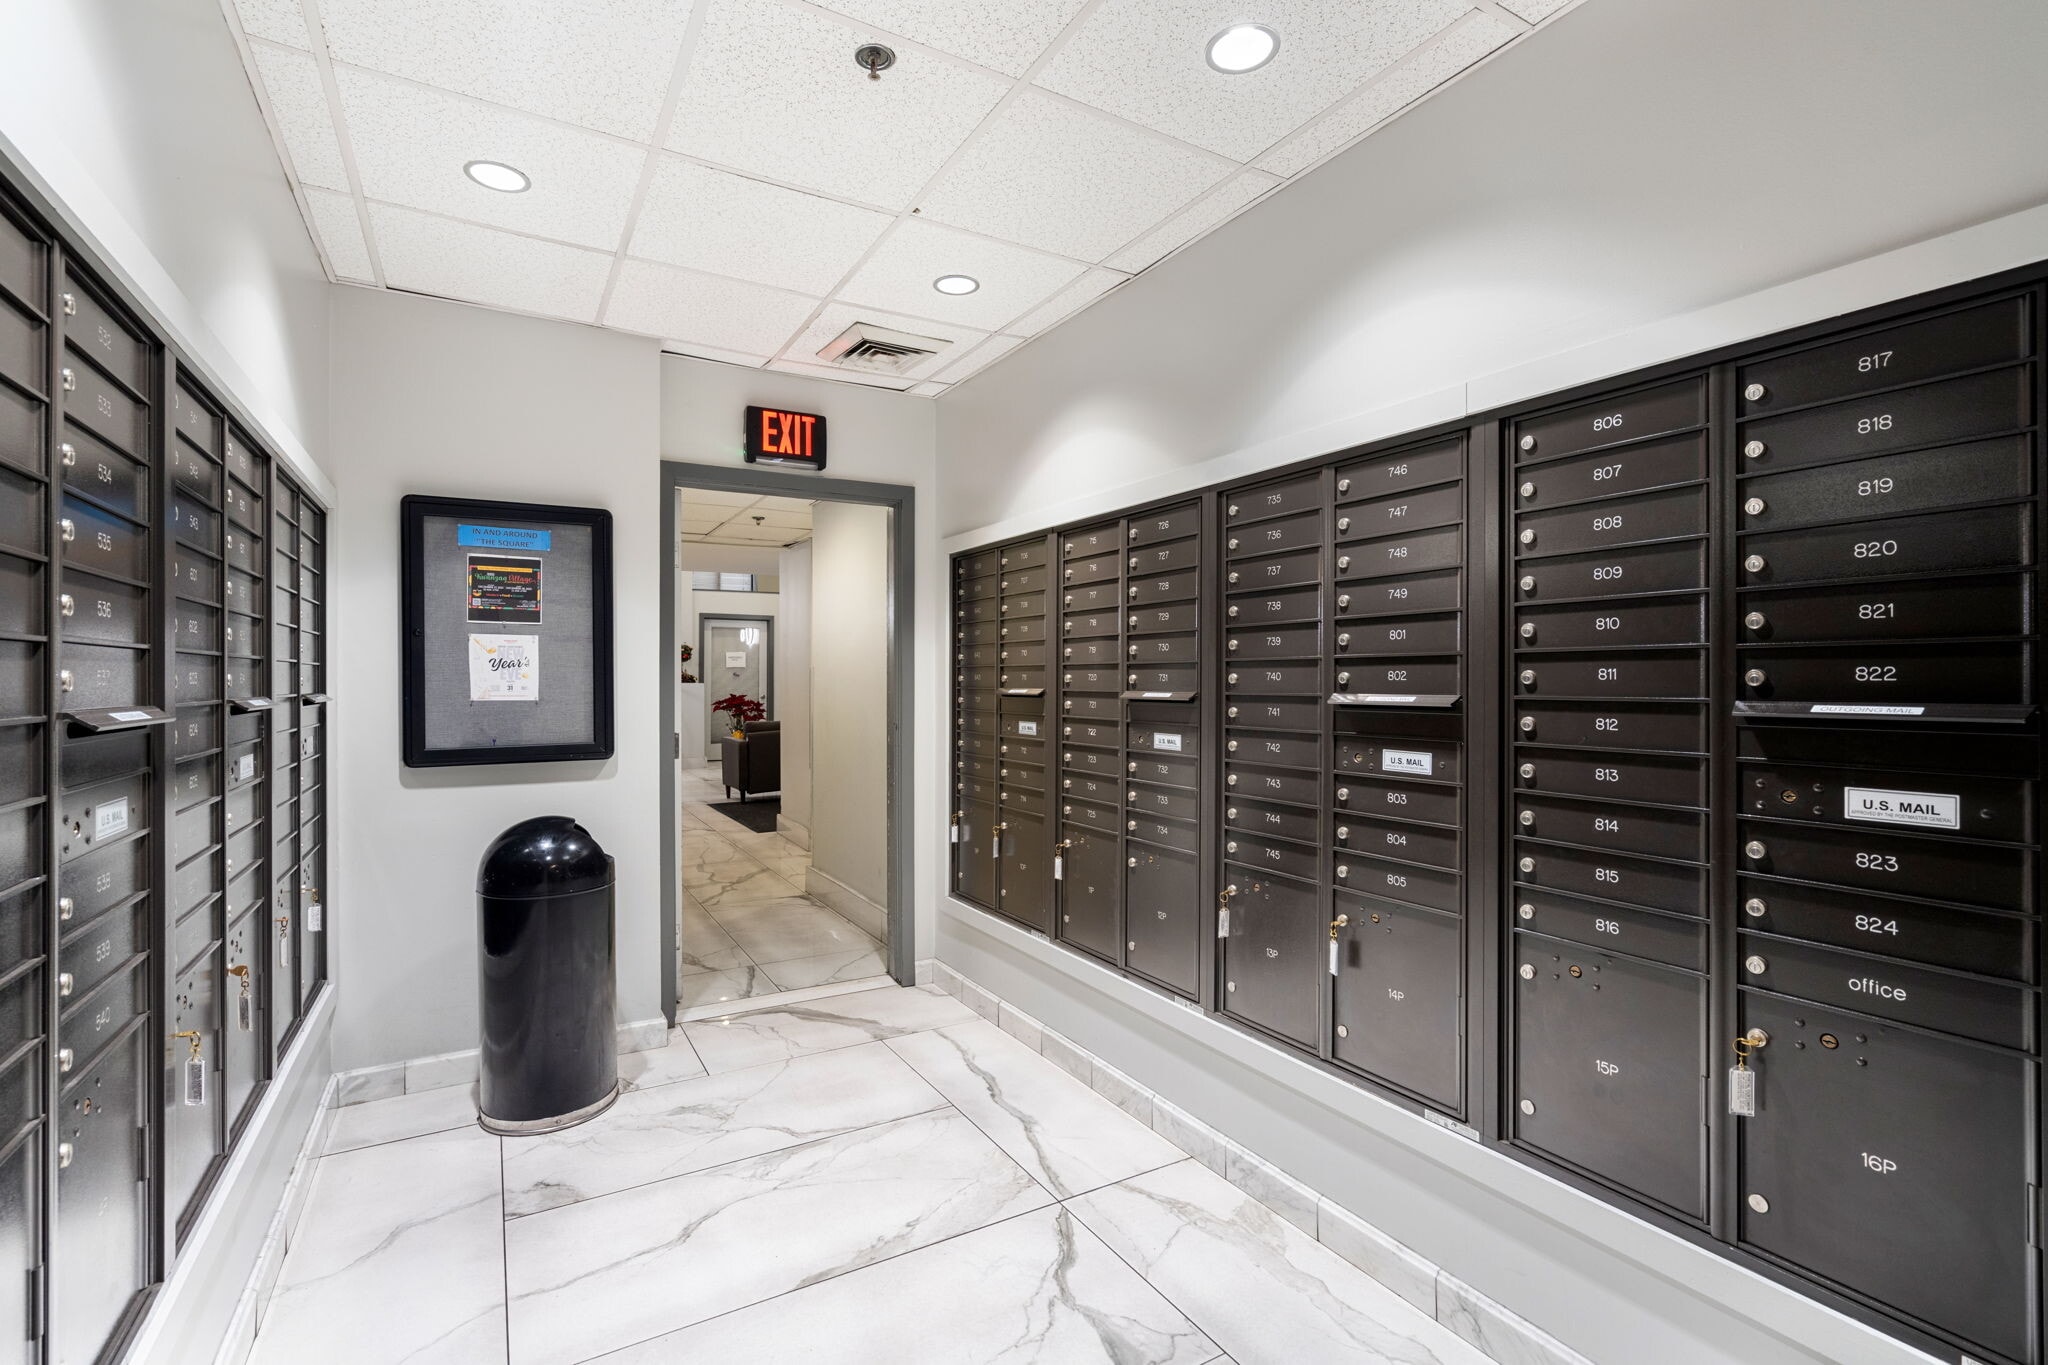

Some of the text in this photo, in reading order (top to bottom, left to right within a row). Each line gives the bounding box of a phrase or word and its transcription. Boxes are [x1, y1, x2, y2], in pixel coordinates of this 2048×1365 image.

[98, 325, 112, 351] 532
[1857, 350, 1893, 372] 817
[98, 394, 112, 418] 533
[1593, 413, 1623, 432] 806
[1857, 414, 1893, 434] 818
[762, 410, 816, 457] EXIT
[98, 463, 112, 484] 534
[1387, 464, 1408, 478] 746
[1593, 463, 1623, 481] 807
[1857, 477, 1894, 496] 819
[1266, 493, 1282, 505] 735
[1388, 505, 1408, 519] 747
[1157, 520, 1170, 530] 726
[1593, 515, 1623, 531] 808
[472, 527, 538, 539] IN AND AROUND
[1266, 529, 1282, 541] 736
[97, 532, 112, 552] 535
[498, 540, 534, 548] SQUARE"
[1853, 539, 1898, 559] 820
[1158, 550, 1170, 561] 727
[1387, 546, 1408, 559] 748
[1266, 565, 1282, 576] 737
[1593, 565, 1623, 581] 809
[1158, 581, 1170, 591] 728
[1387, 587, 1408, 600] 749
[97, 600, 112, 618] 536
[1266, 600, 1282, 611] 738
[1858, 602, 1894, 620] 821
[1158, 612, 1170, 621] 729
[1595, 616, 1620, 631] 810
[1266, 636, 1282, 646] 739
[1389, 629, 1406, 641] 801
[1157, 643, 1170, 652] 730
[488, 656, 530, 672] Year's
[1087, 673, 1098, 681] 720
[1158, 673, 1168, 682] 731
[1266, 671, 1282, 681] 740
[1387, 670, 1408, 681] 802
[1597, 668, 1617, 681] 811
[1855, 665, 1897, 682] 822
[1267, 707, 1280, 717] 741
[1820, 705, 1883, 713] OUTGOING
[1087, 727, 1097, 736] 722
[1595, 717, 1619, 732] 812
[1265, 742, 1281, 753] 742
[1157, 764, 1169, 774] 732
[1390, 757, 1405, 765] U.S.
[1406, 758, 1424, 767] MAIL
[1595, 768, 1619, 782] 813
[1086, 782, 1097, 791] 724
[1265, 777, 1281, 789] 743
[1156, 795, 1169, 805] 733
[1387, 792, 1408, 805] 803
[1087, 809, 1097, 819] 725
[1863, 799, 1941, 816] U.S. MAIL
[101, 806, 124, 827] U.S. MAIL
[1265, 812, 1281, 824] 744
[1156, 824, 1168, 835] 734
[1594, 817, 1620, 833] 814
[1386, 833, 1407, 847] 804
[1265, 848, 1281, 860] 745
[1855, 852, 1899, 872] 823
[96, 872, 111, 893] 538
[1386, 873, 1407, 888] 805
[1595, 867, 1619, 884] 815
[1595, 918, 1620, 935] 816
[1855, 914, 1899, 936] 824
[96, 939, 111, 963] 539
[1388, 988, 1405, 1001] 14P
[1848, 977, 1907, 1002] office
[95, 1006, 110, 1032] 540
[1595, 1059, 1619, 1076] 15P
[1861, 1152, 1897, 1175] 16P
